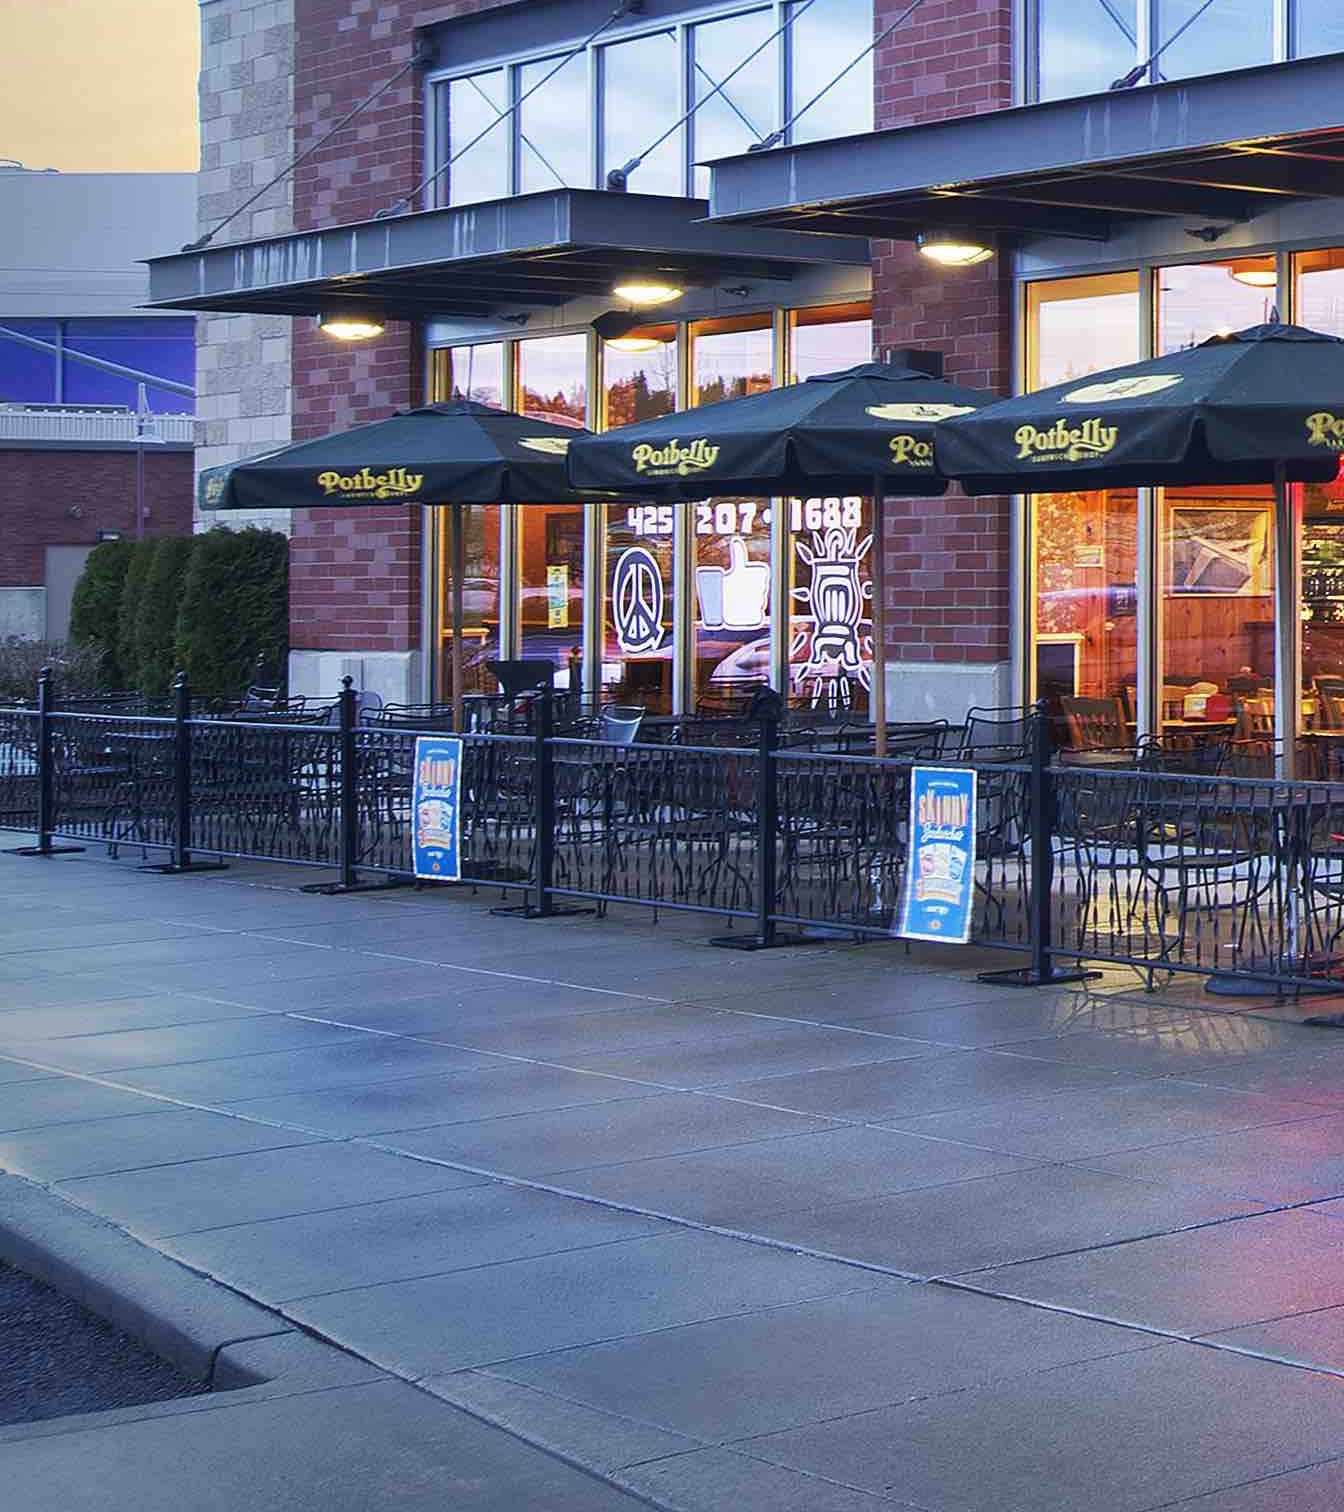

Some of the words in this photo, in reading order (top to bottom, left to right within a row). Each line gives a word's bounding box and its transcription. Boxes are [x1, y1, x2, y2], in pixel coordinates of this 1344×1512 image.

[632, 438, 720, 473] Potbelly
[1014, 417, 1119, 459] Potbelly
[318, 467, 424, 497] Potbelly
[626, 506, 673, 536] 425
[696, 501, 757, 535] 207
[791, 496, 862, 532] 1688
